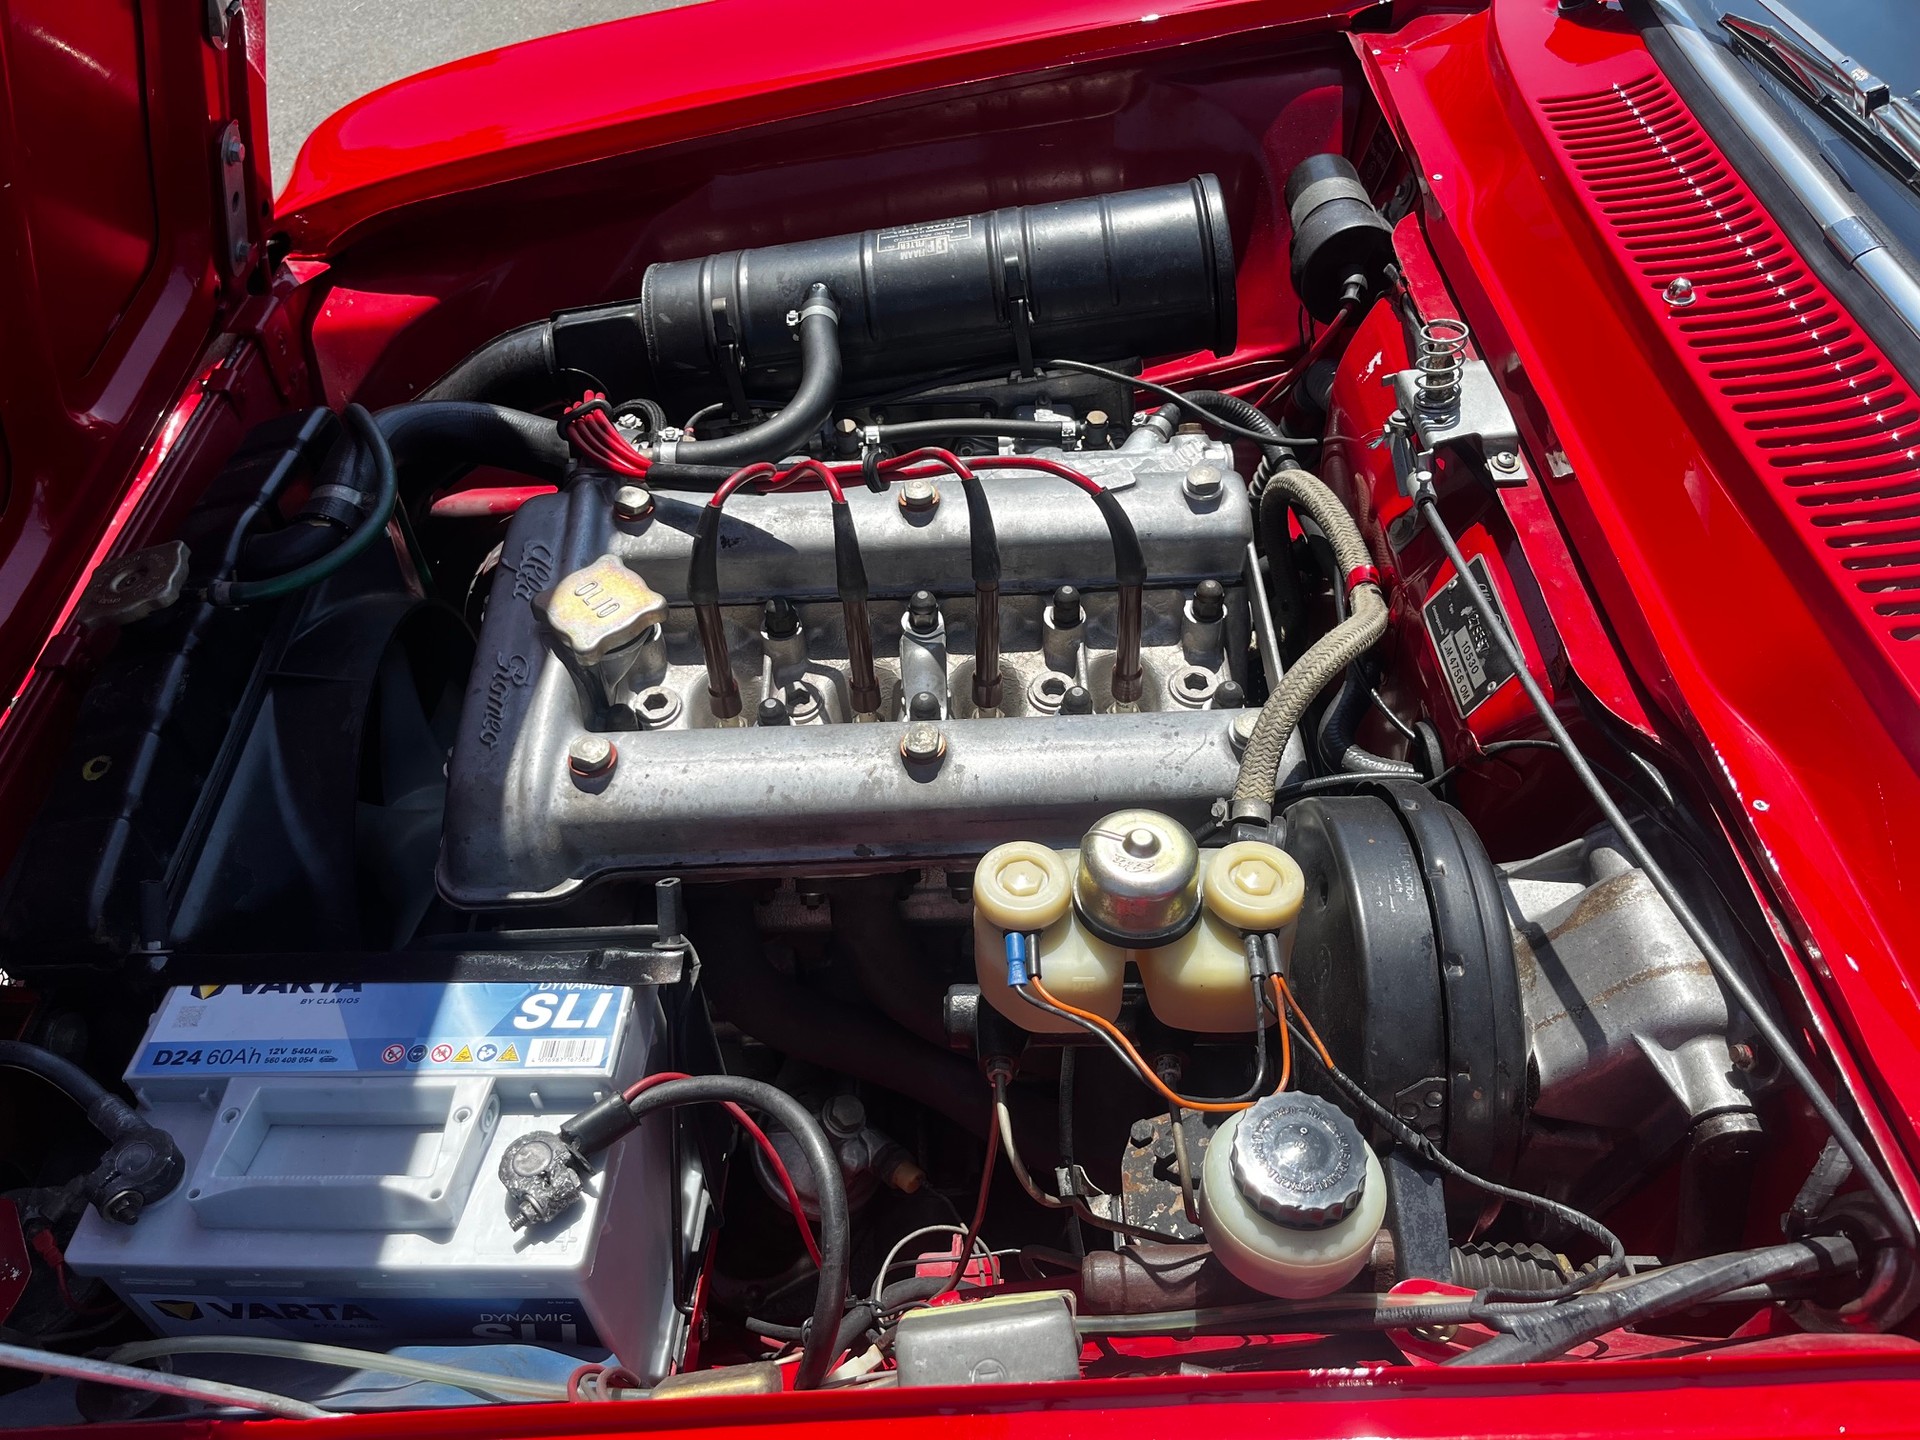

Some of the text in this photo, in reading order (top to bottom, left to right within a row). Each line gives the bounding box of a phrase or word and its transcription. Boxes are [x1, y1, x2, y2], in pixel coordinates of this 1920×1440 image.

[900, 240, 925, 250] FILTER
[900, 249, 925, 260] FIAAM
[501, 541, 552, 601] Alfa
[574, 581, 620, 619] OLIO
[1461, 640, 1479, 675] 10530
[1449, 657, 1465, 684] 4756
[480, 652, 530, 750] Romeo
[316, 997, 360, 1005] CLARIOS
[513, 993, 613, 1030] SLI
[152, 1050, 202, 1066] D24
[206, 1048, 262, 1065] 60Ah
[205, 1302, 379, 1321] VARTA
[480, 1313, 572, 1322] DYNAMIC
